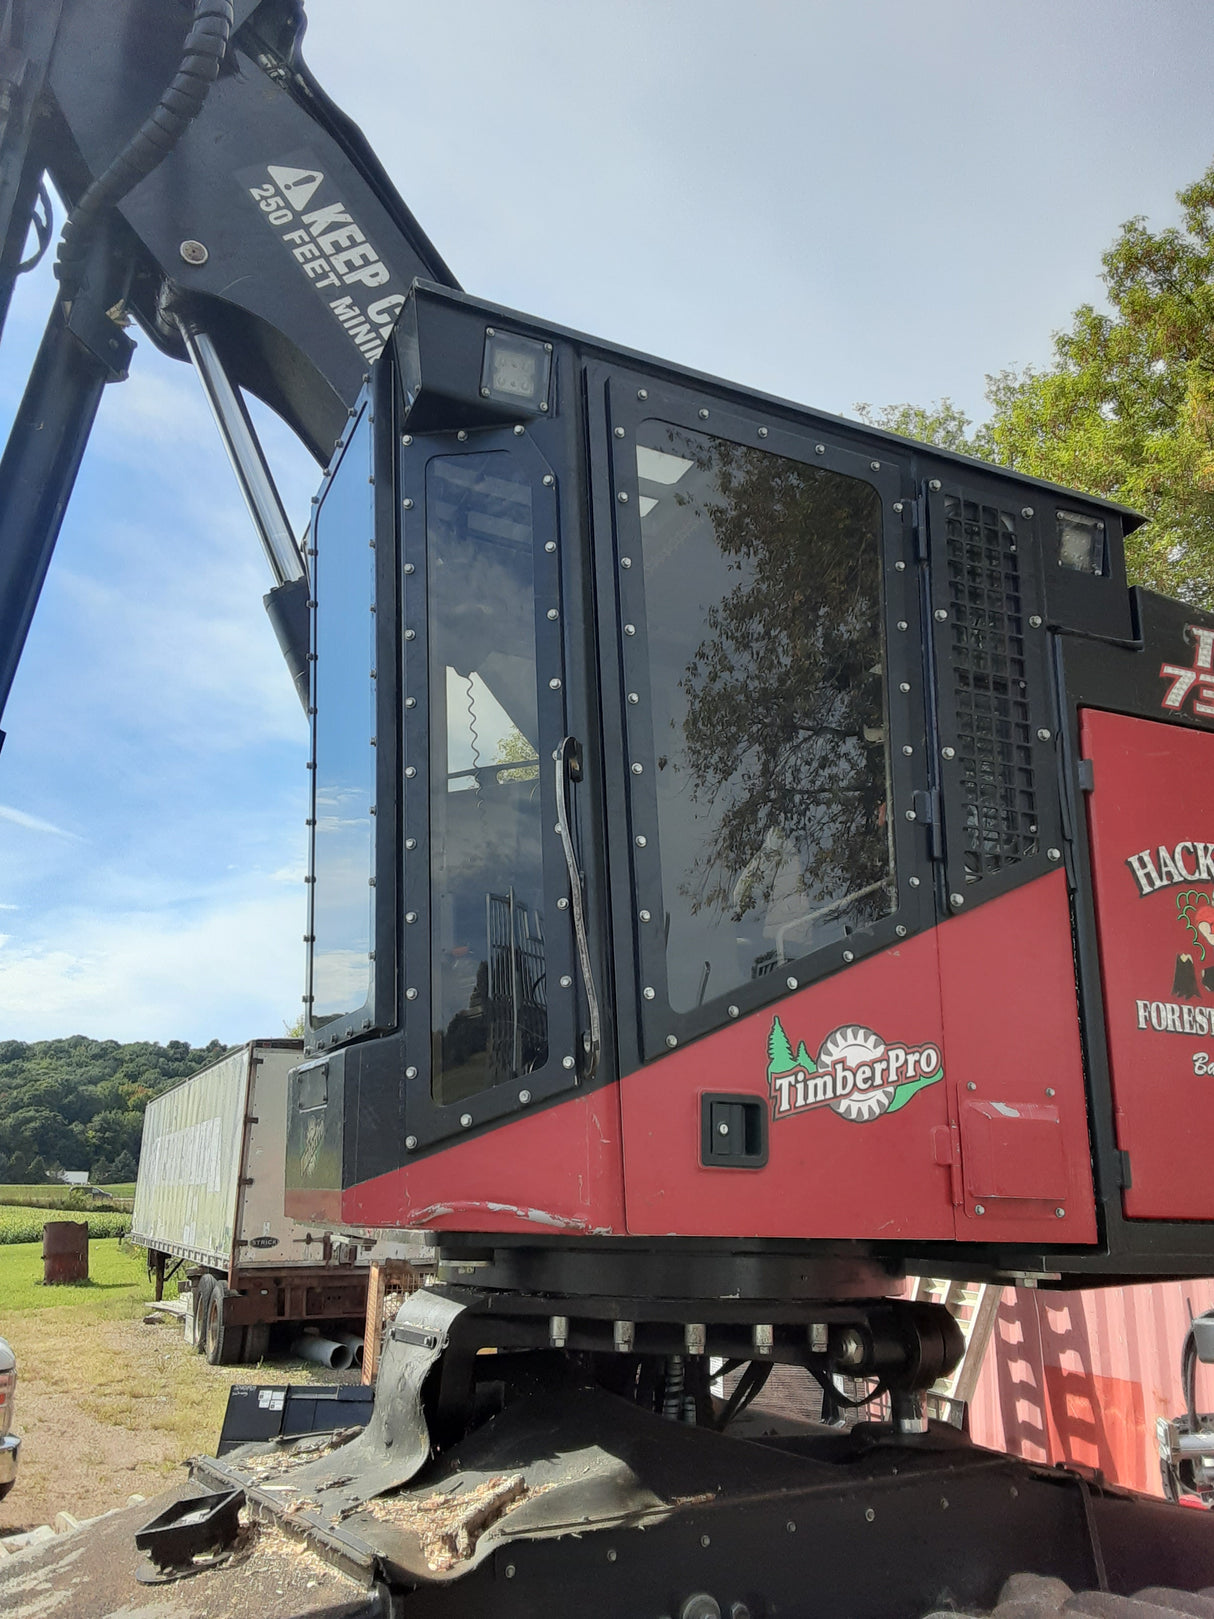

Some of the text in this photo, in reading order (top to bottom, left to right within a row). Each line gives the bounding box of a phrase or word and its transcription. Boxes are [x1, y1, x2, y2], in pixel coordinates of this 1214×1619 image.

[250, 184, 293, 226] 250
[282, 228, 341, 289] FEET
[301, 202, 390, 287] KEEP
[1127, 842, 1214, 896] HACK
[774, 1048, 937, 1112] TimberPro
